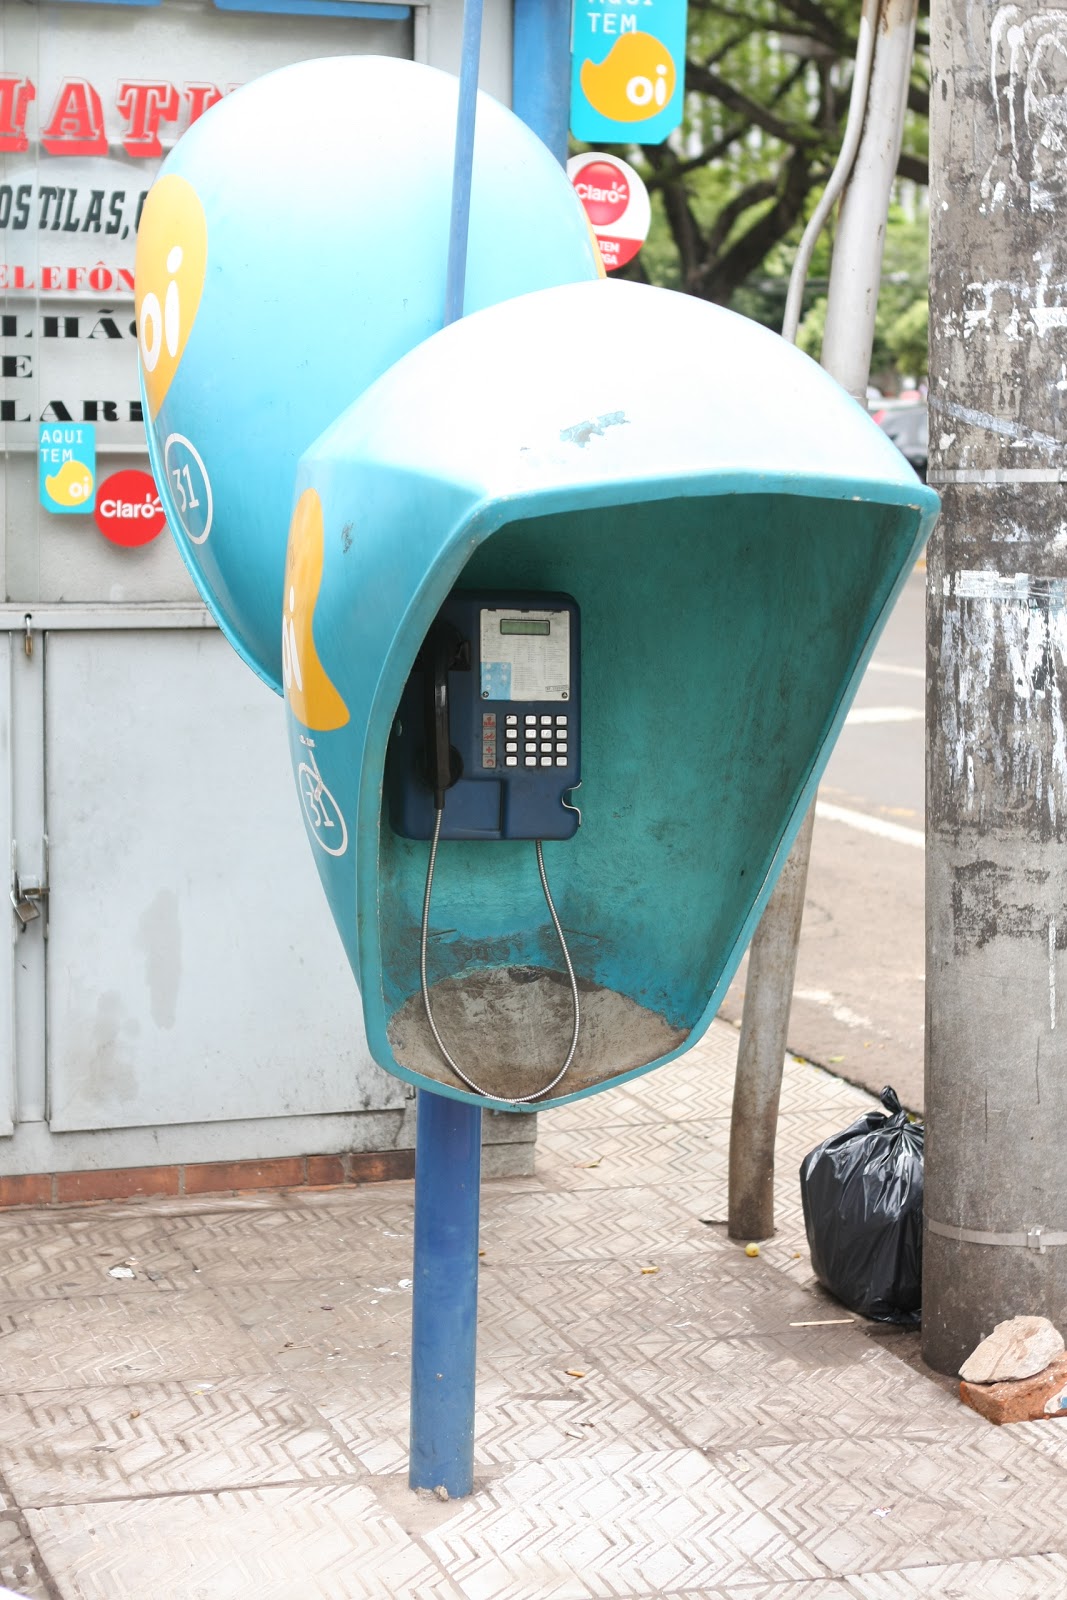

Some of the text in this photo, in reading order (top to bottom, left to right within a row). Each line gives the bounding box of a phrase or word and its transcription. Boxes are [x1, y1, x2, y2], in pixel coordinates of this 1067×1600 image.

[587, 11, 638, 35] TEM
[626, 63, 668, 107] oi
[575, 182, 622, 204] Claro
[140, 245, 184, 372] oi
[1, 355, 33, 378] E
[40, 429, 84, 444] AQUI
[40, 449, 74, 463] TEM
[68, 475, 90, 498] oi
[172, 463, 200, 513] 31
[100, 495, 158, 519] Claro
